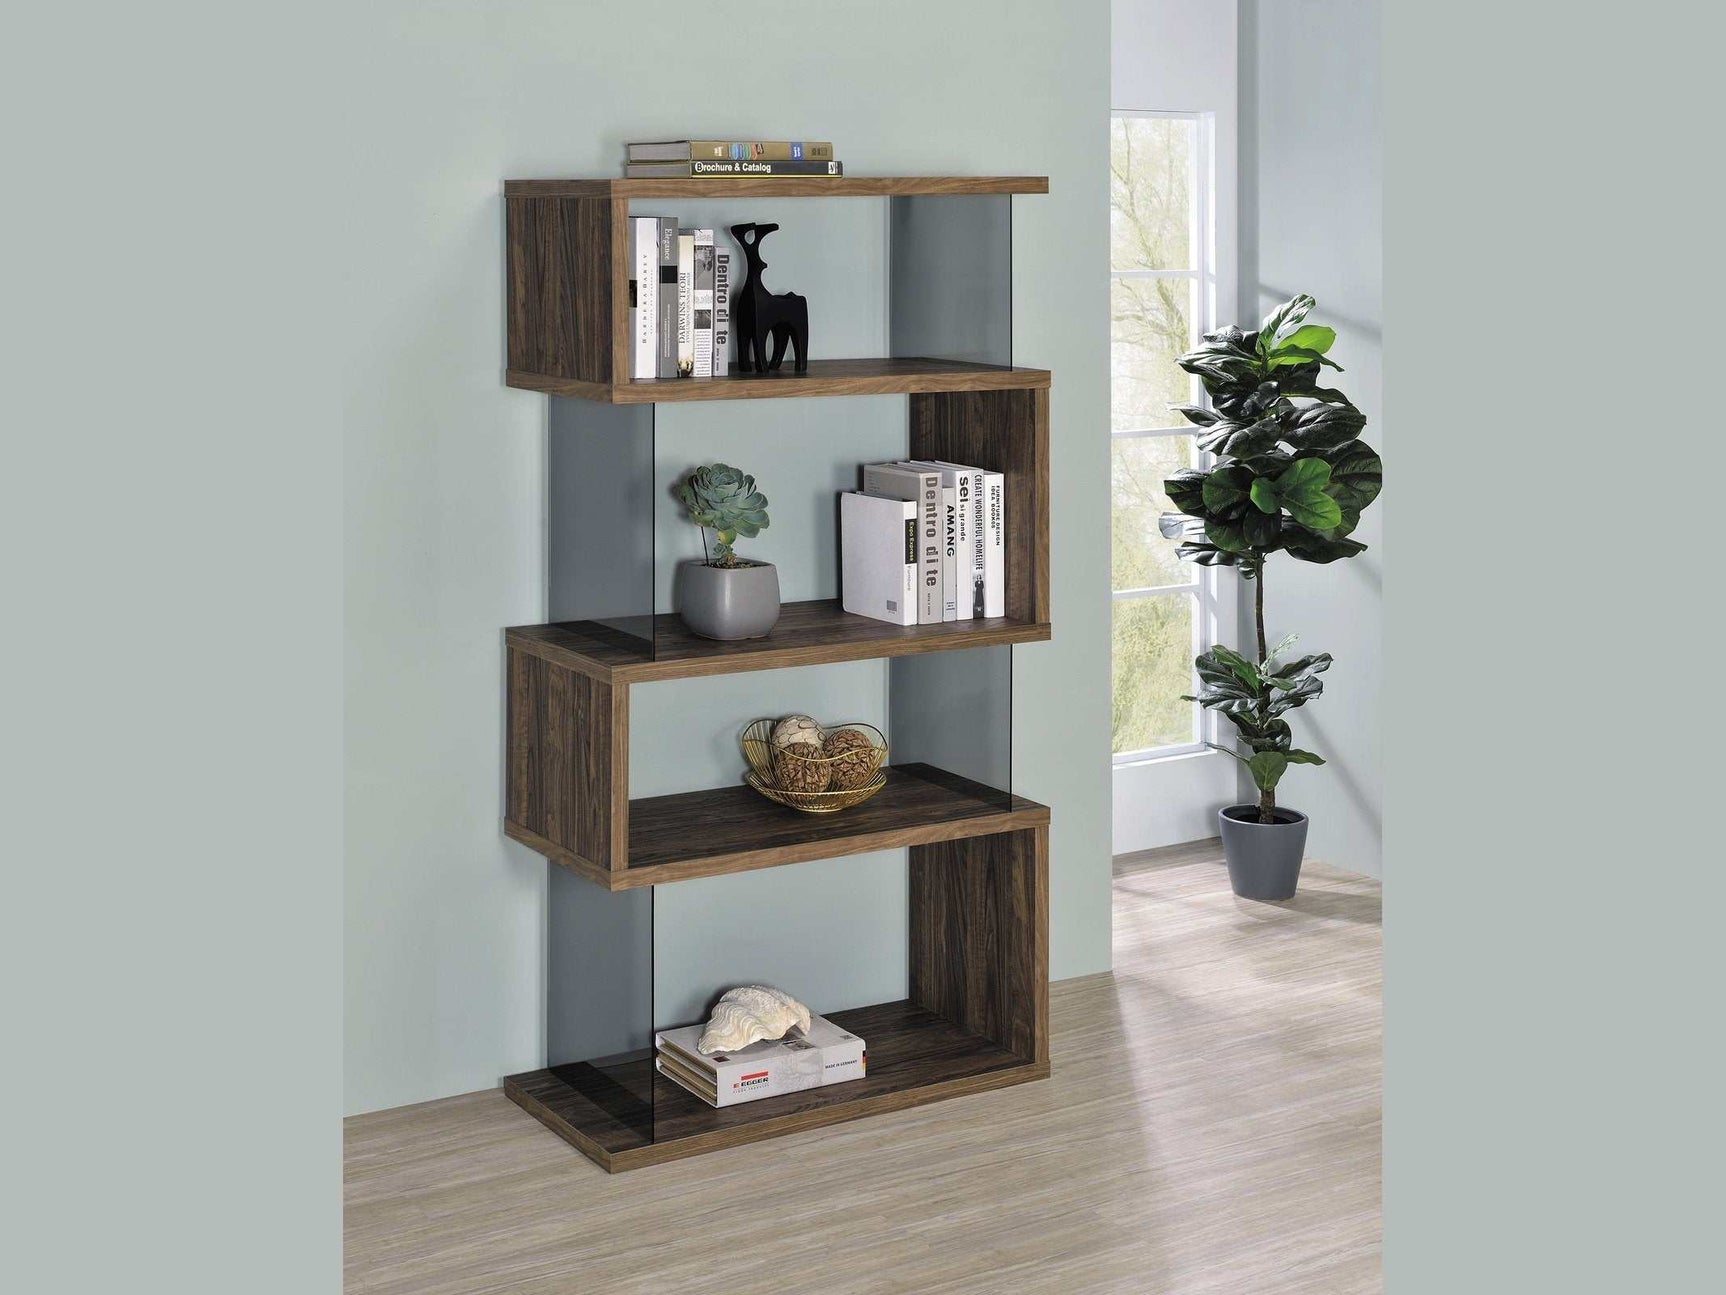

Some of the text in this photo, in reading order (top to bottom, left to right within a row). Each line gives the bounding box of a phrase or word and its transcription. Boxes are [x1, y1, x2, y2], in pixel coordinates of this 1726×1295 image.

[695, 162, 772, 174] Brochure & Catalog
[663, 228, 672, 261] Elegance
[678, 272, 686, 344] DARWINS TEORI
[716, 254, 729, 345] Dentro di te
[925, 476, 939, 587] Dentro di te
[947, 504, 955, 558] AMANG
[959, 504, 966, 512] si
[974, 474, 983, 571] CREATE WONDERFUL HOMELIFE
[741, 1077, 769, 1087] EGGER
